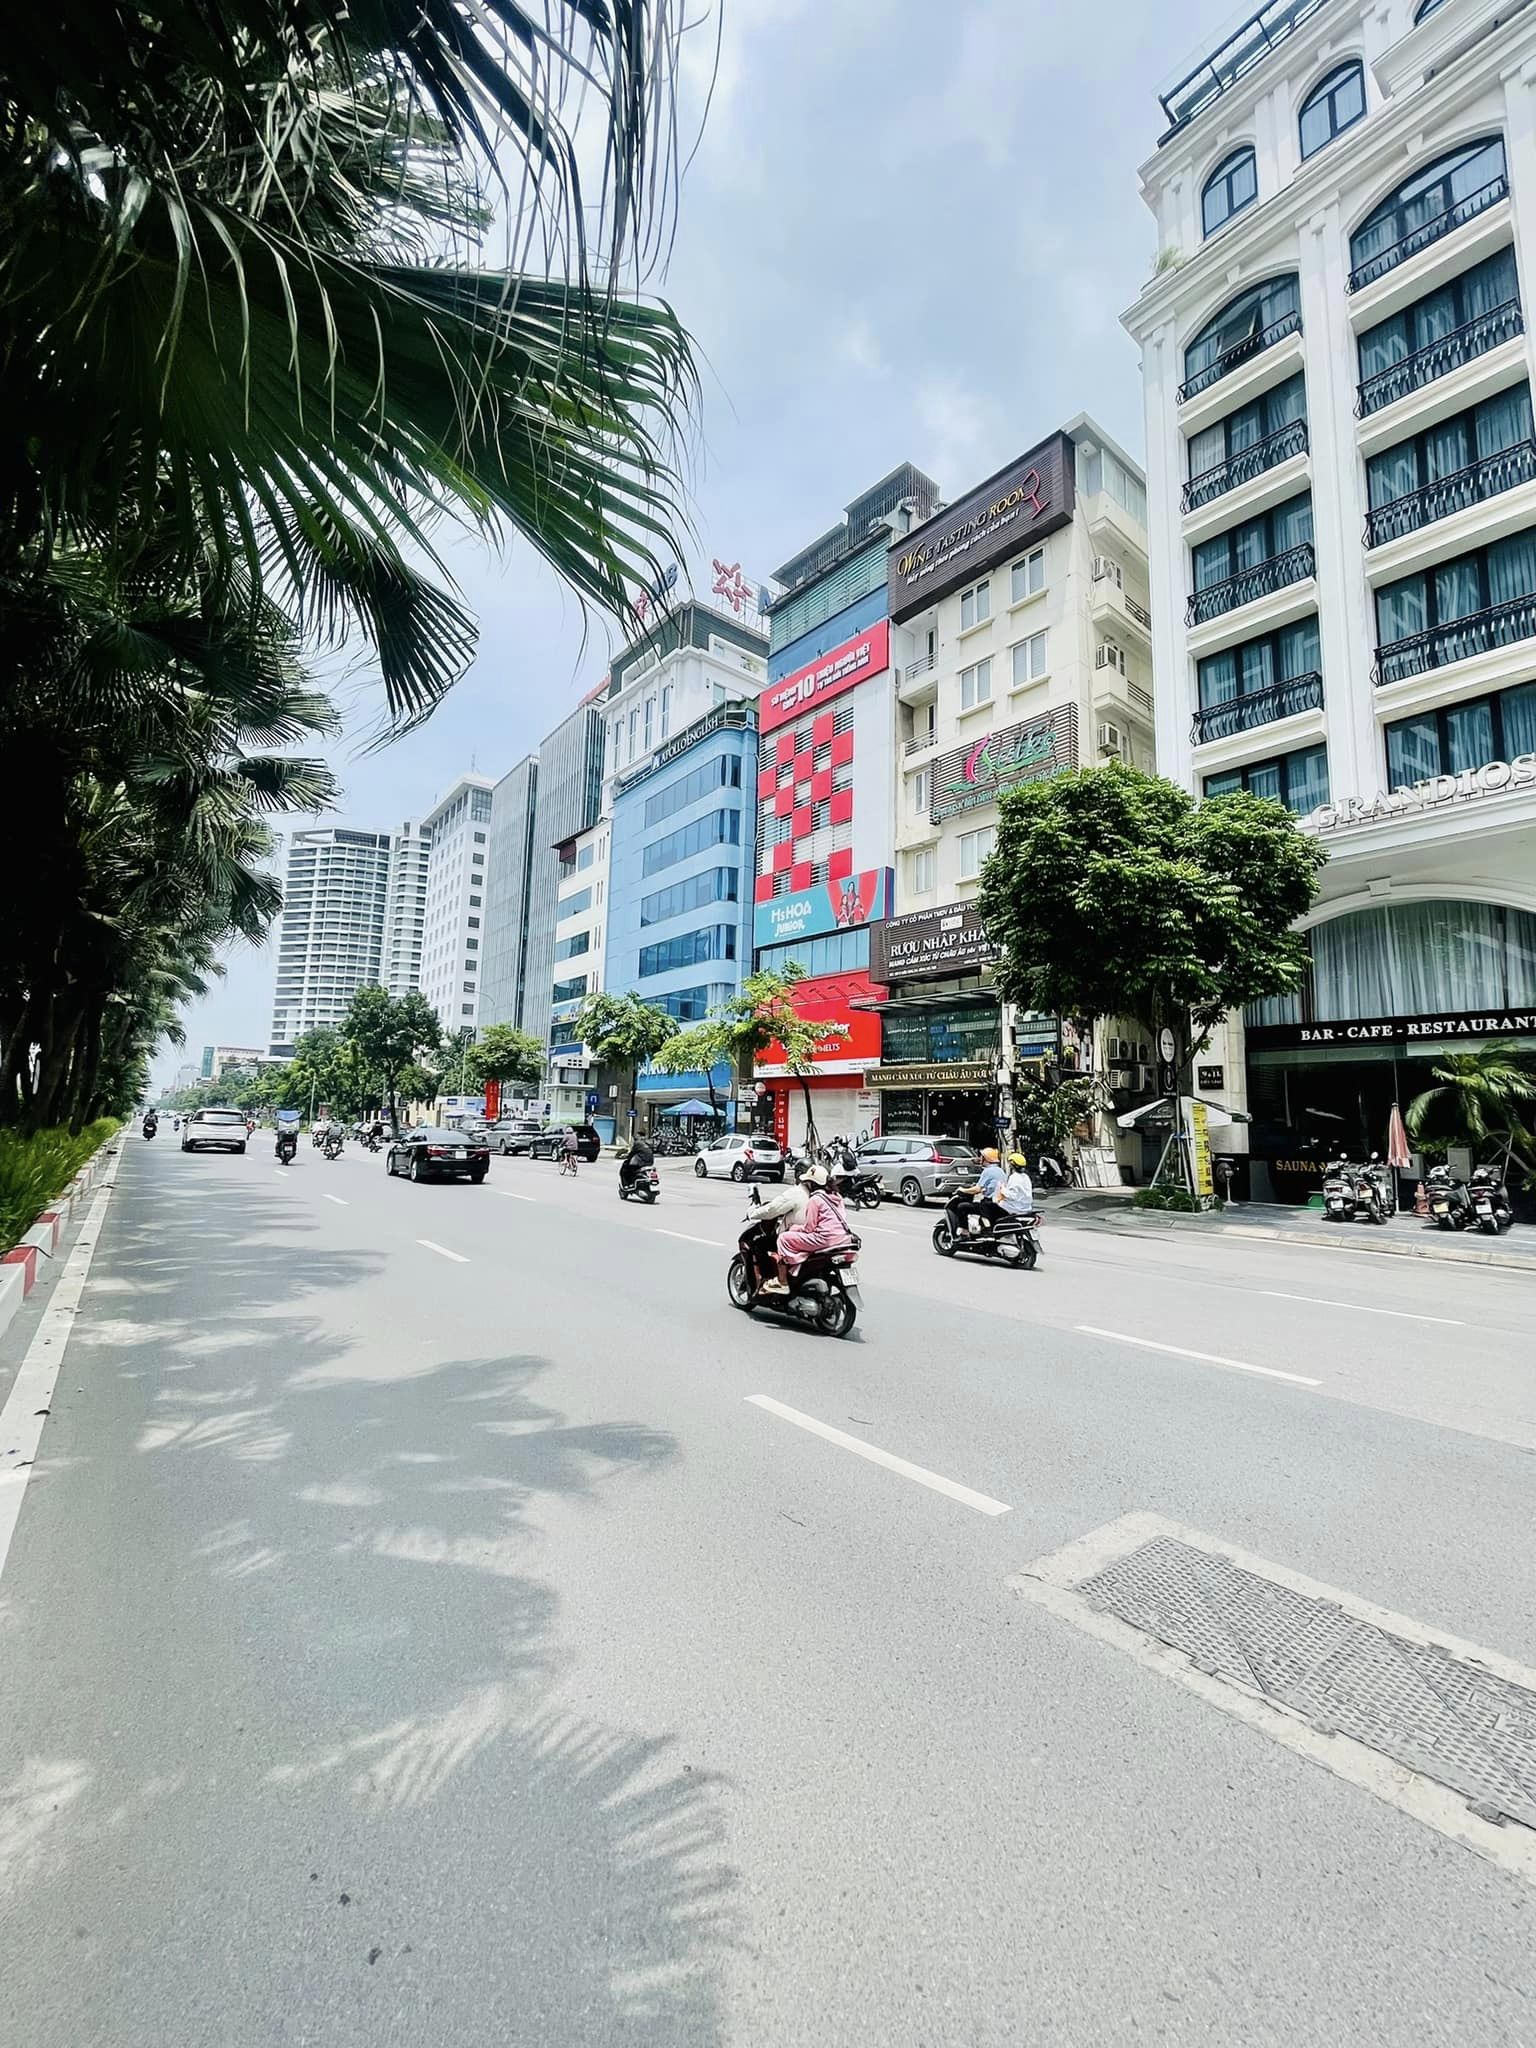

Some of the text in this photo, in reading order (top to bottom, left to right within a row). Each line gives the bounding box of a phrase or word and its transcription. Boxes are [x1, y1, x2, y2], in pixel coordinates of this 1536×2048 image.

[897, 543, 934, 578] WINE
[936, 511, 987, 554] TASTING
[797, 674, 816, 702] 10
[885, 920, 900, 929] CÔNG
[890, 939, 920, 958] RƯỢU
[922, 932, 957, 951] NHẬP
[1300, 1028, 1335, 1041] BAR
[1346, 1024, 1393, 1038] CAFE
[871, 1073, 892, 1081] MANG
[892, 1071, 908, 1081] CẢM
[936, 1069, 959, 1080] CHÂU
[960, 1068, 972, 1079] ÂU
[1275, 1159, 1318, 1172] SAUNA
